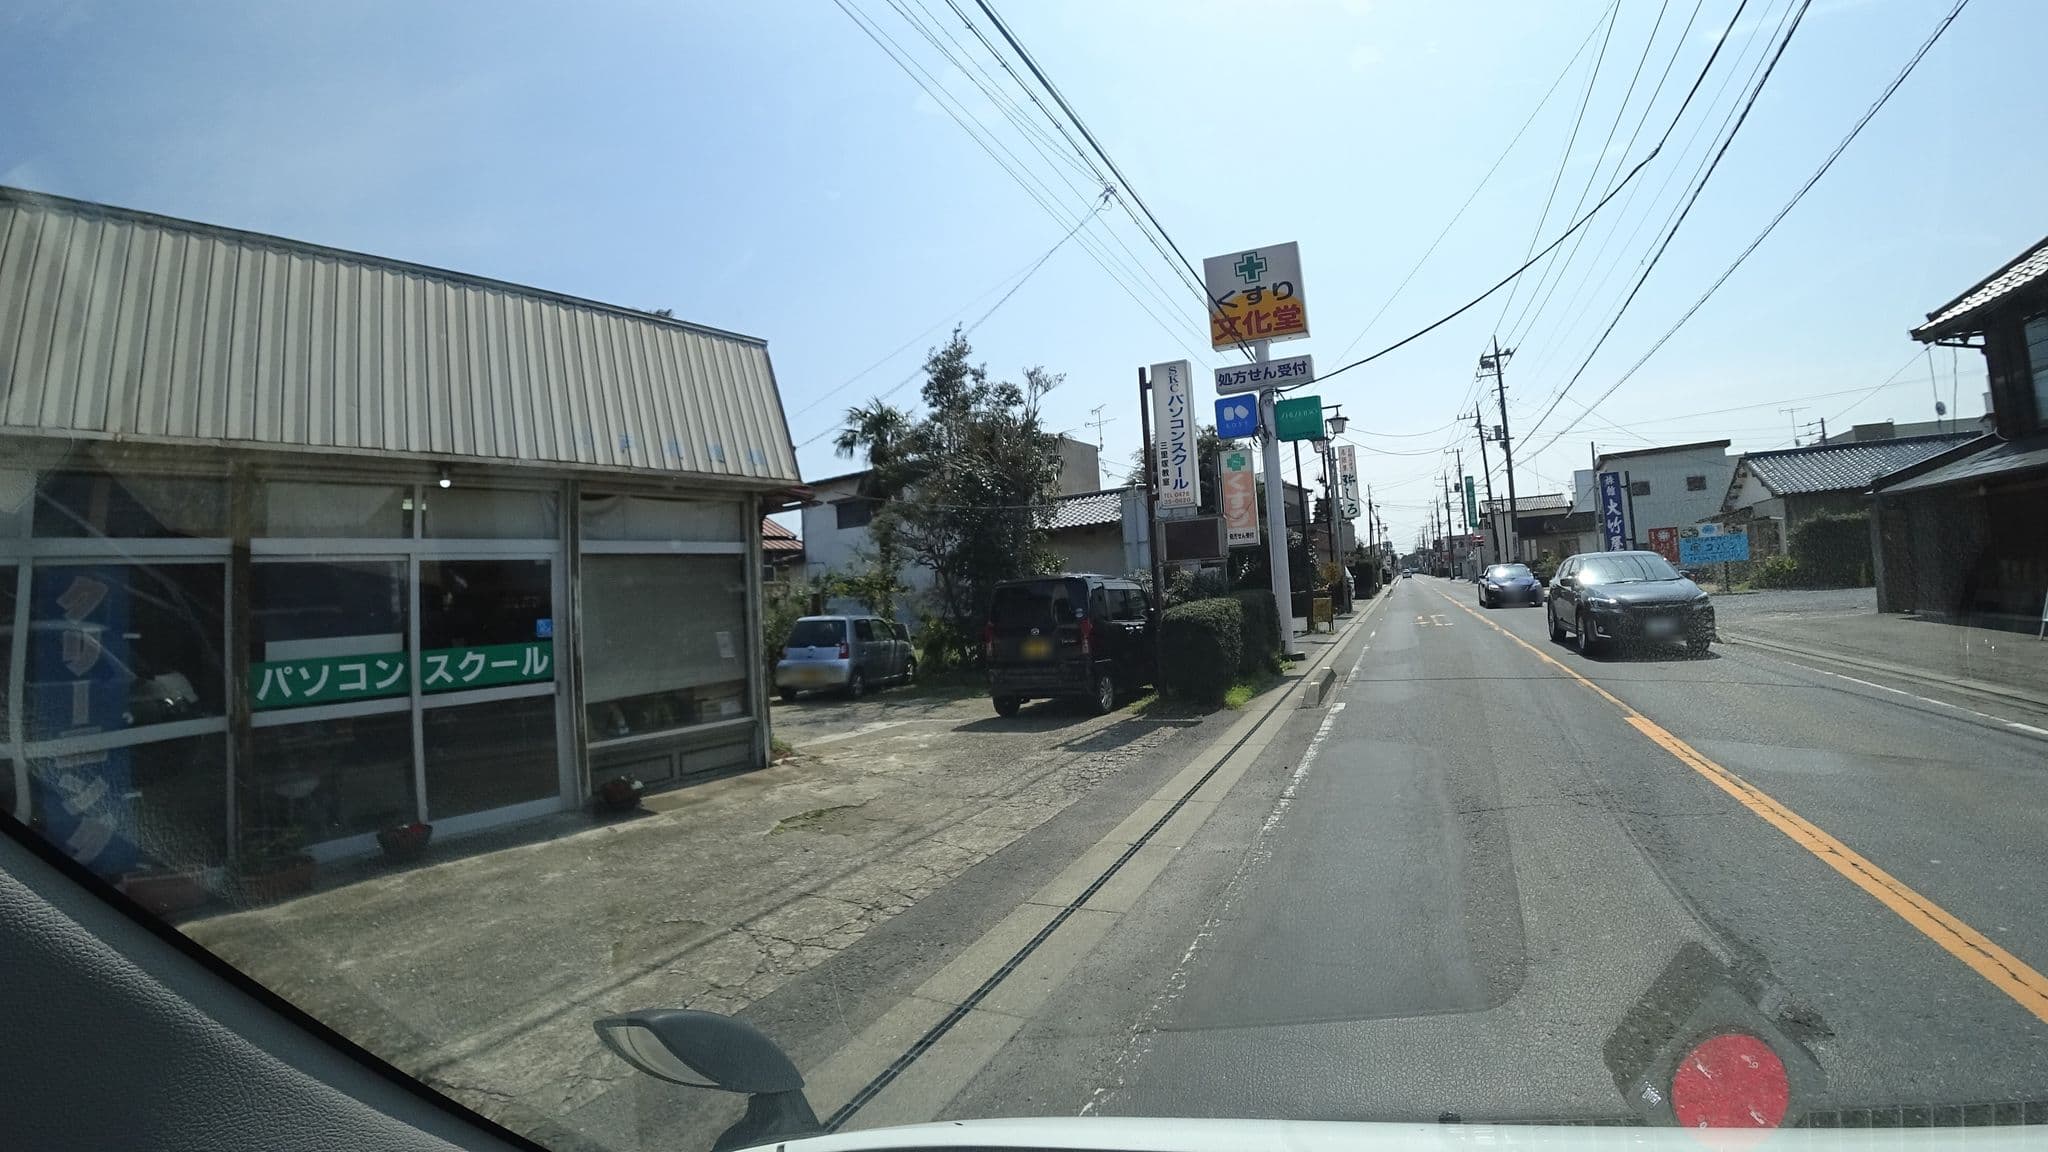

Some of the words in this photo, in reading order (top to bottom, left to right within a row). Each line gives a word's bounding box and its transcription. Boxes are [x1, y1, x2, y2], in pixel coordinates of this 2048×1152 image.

[1216, 280, 1294, 308] くすり
[1213, 304, 1303, 341] 文化堂
[1217, 360, 1308, 387] 処方せん受付
[1606, 498, 1624, 552] 大竹屋
[255, 645, 550, 702] パソコンスクール
